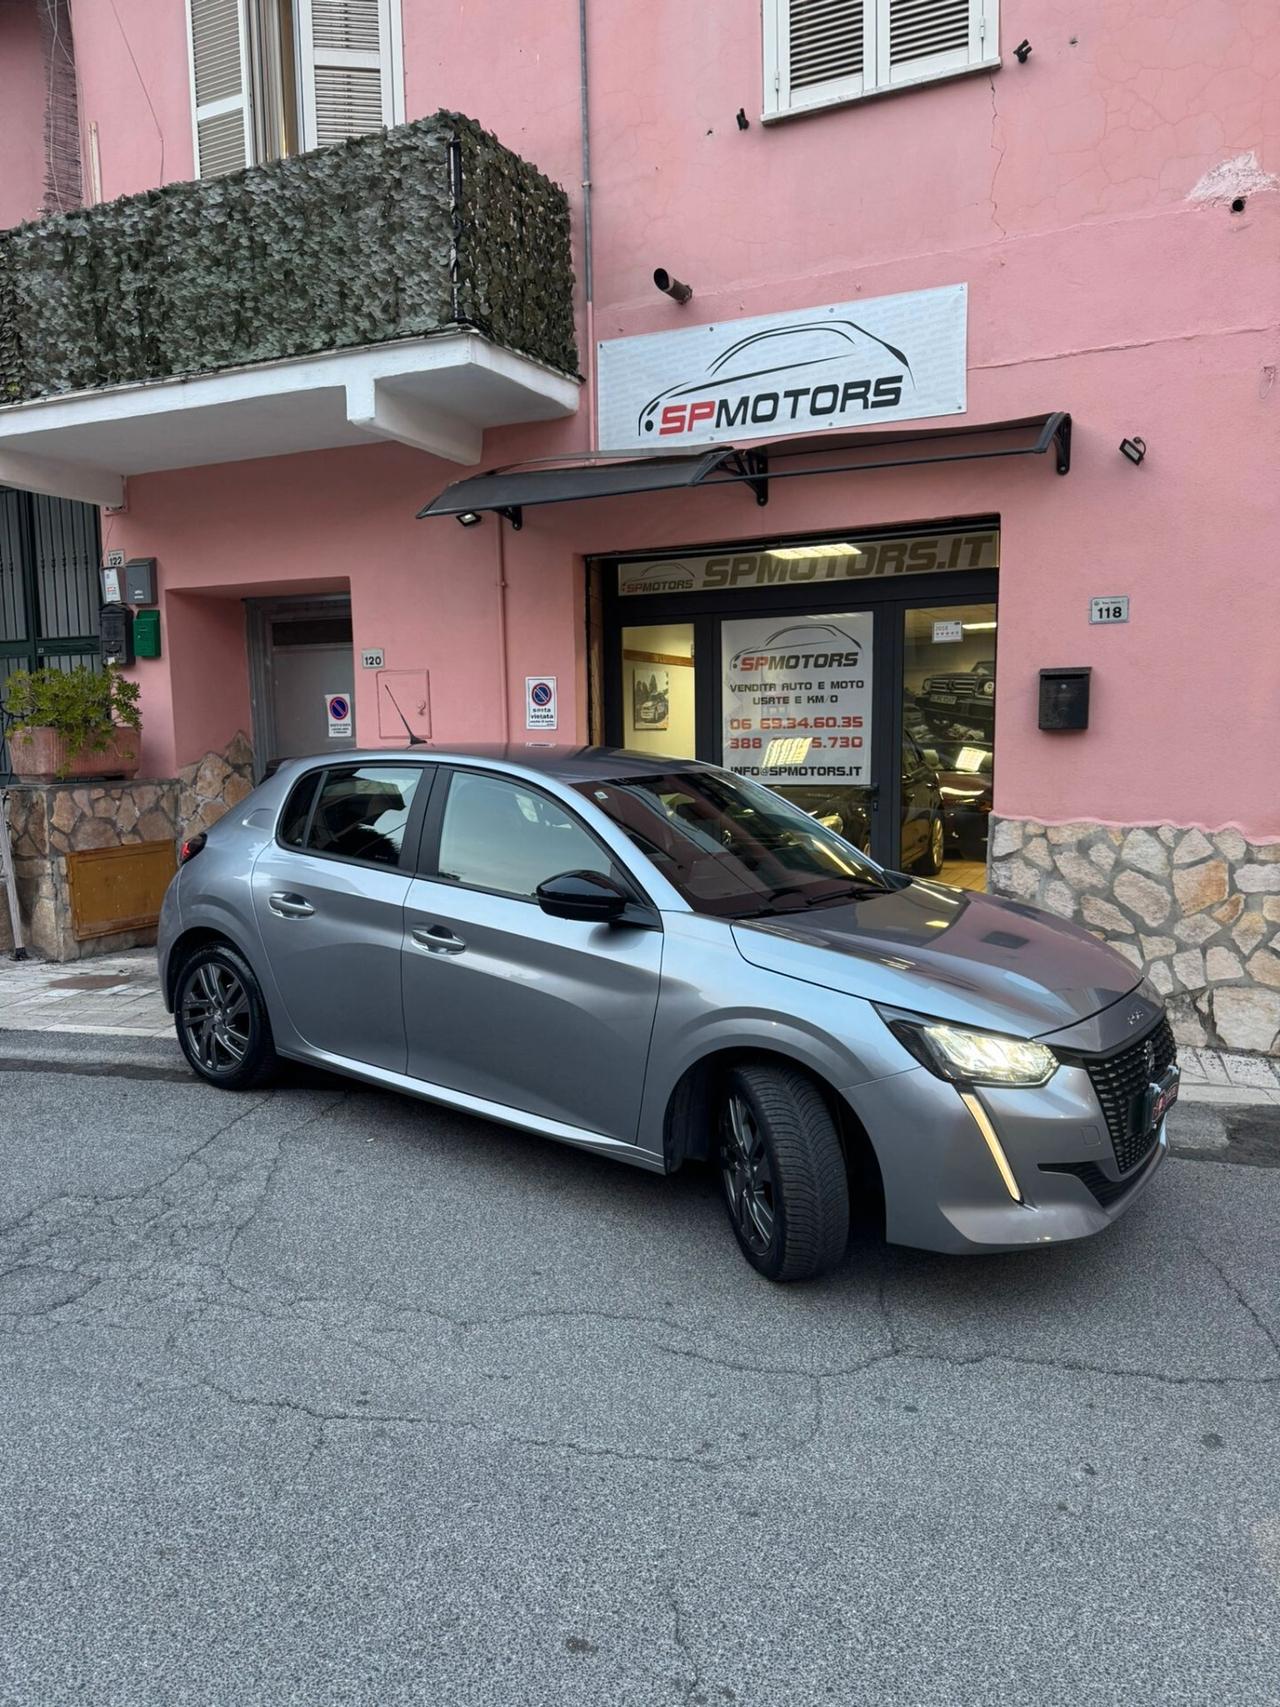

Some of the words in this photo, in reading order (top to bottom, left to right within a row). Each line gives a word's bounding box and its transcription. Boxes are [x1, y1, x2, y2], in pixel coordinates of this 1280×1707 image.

[659, 375, 904, 436] SPMOTORS
[109, 557, 122, 566] 122
[702, 534, 994, 588] SPMOTORS.IT
[626, 579, 694, 594] SPMOTORS
[1097, 606, 1122, 619] 118
[364, 656, 382, 666] 120
[740, 652, 859, 672] SPMOTORS
[730, 683, 777, 693] VENDITA
[781, 681, 812, 691] AUTO
[818, 681, 825, 690] E
[830, 680, 865, 690] MOTO
[752, 696, 790, 705] USATE
[794, 696, 802, 704] E
[730, 718, 752, 730] 06
[760, 716, 863, 730] 69.34.60.35
[730, 737, 762, 749] 388
